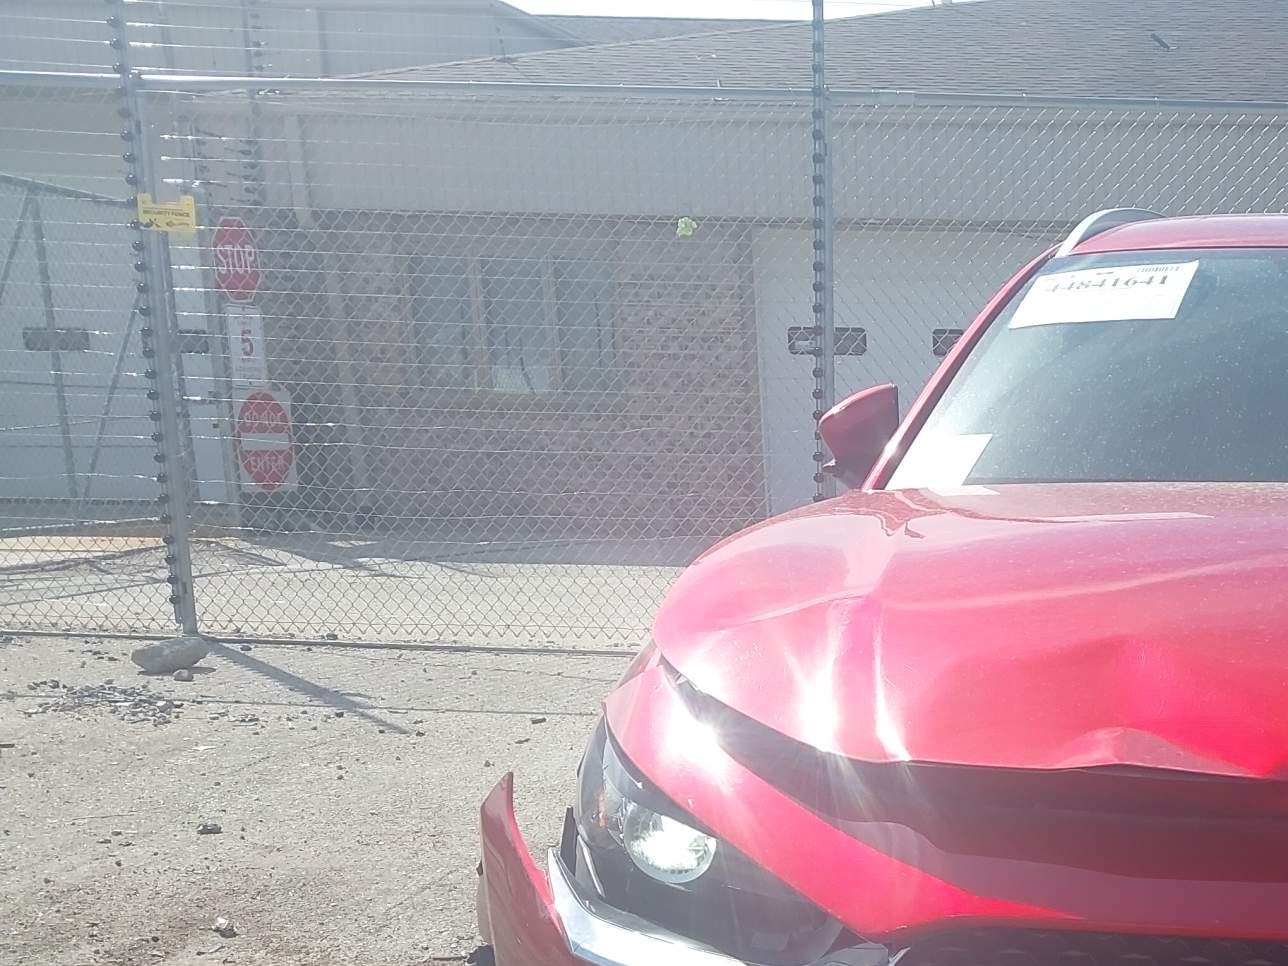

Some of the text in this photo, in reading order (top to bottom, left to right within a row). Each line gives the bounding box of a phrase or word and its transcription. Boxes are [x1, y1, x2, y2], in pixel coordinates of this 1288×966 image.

[216, 244, 256, 275] STOP
[240, 329, 254, 356] 5
[244, 412, 282, 426] DO NOT
[250, 455, 286, 471] ENTER
